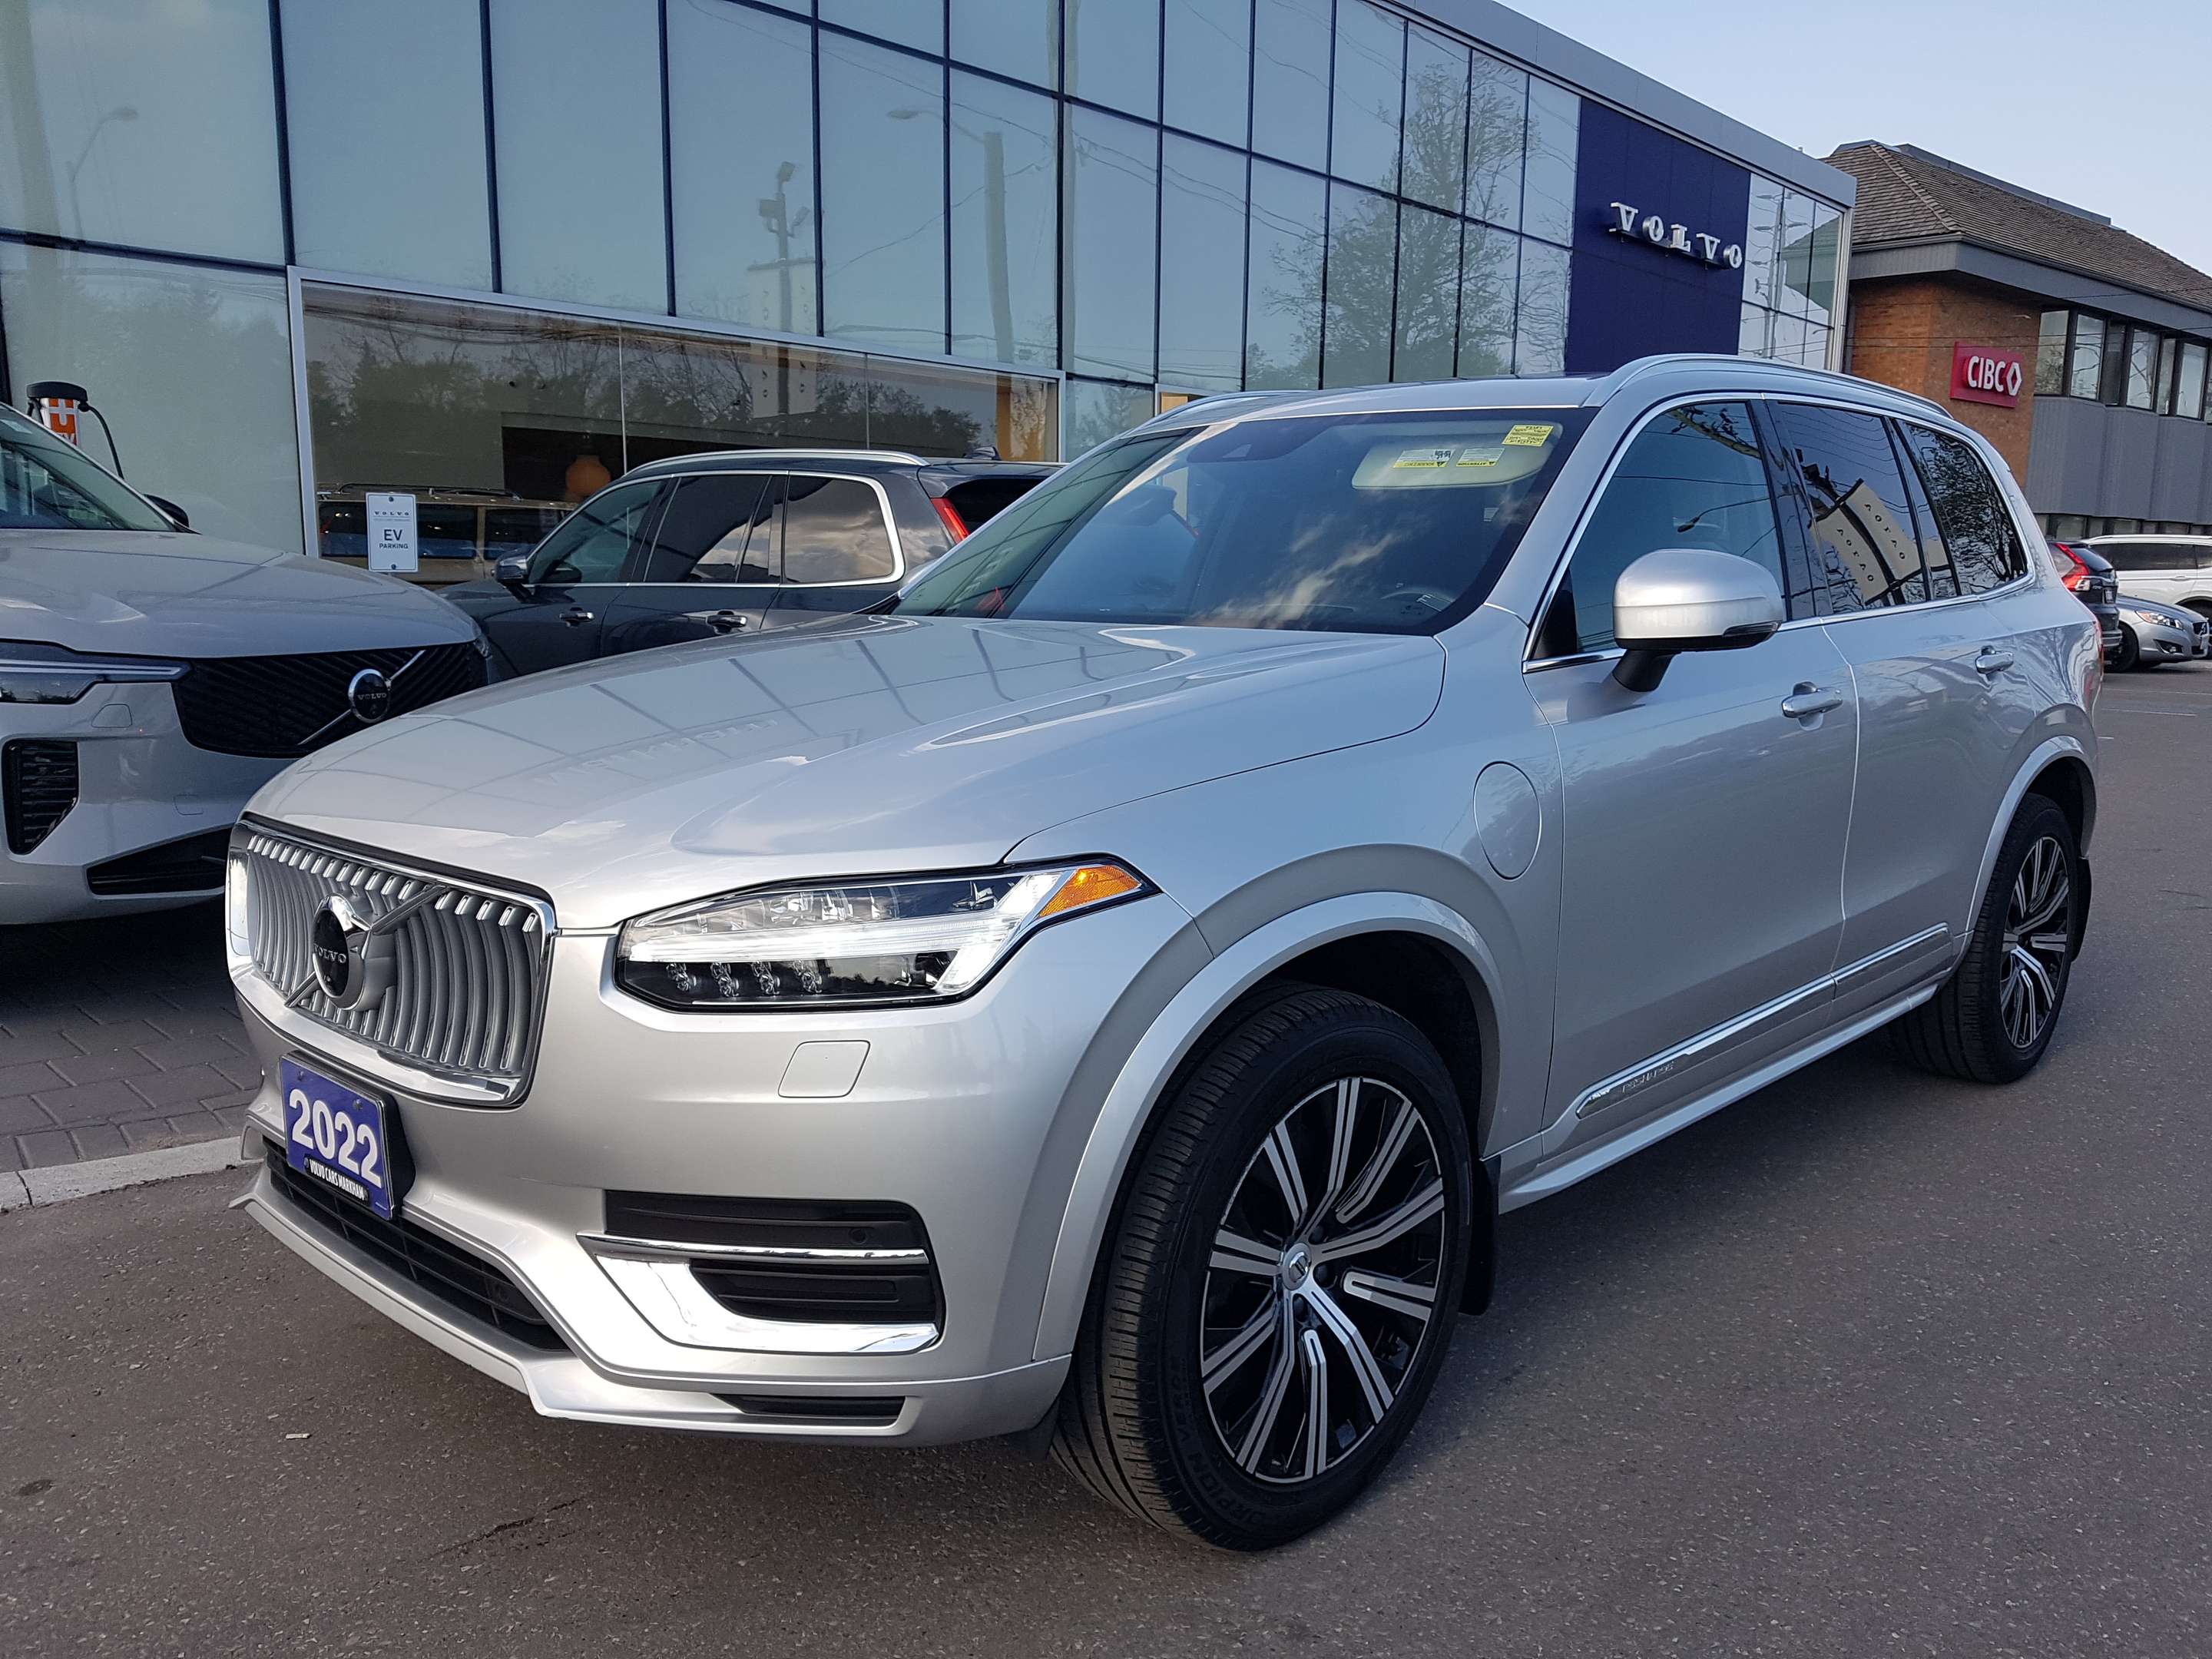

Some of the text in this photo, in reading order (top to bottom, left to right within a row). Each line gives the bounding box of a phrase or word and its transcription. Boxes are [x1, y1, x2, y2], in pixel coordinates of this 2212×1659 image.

[1610, 201, 1743, 269] VOLVO
[1968, 356, 2006, 392] CIBC
[384, 529, 402, 541] EV
[313, 943, 346, 963] VOLVO
[289, 1088, 382, 1189] 2022
[309, 1158, 365, 1201] VOLVO CARS MARKHAM
